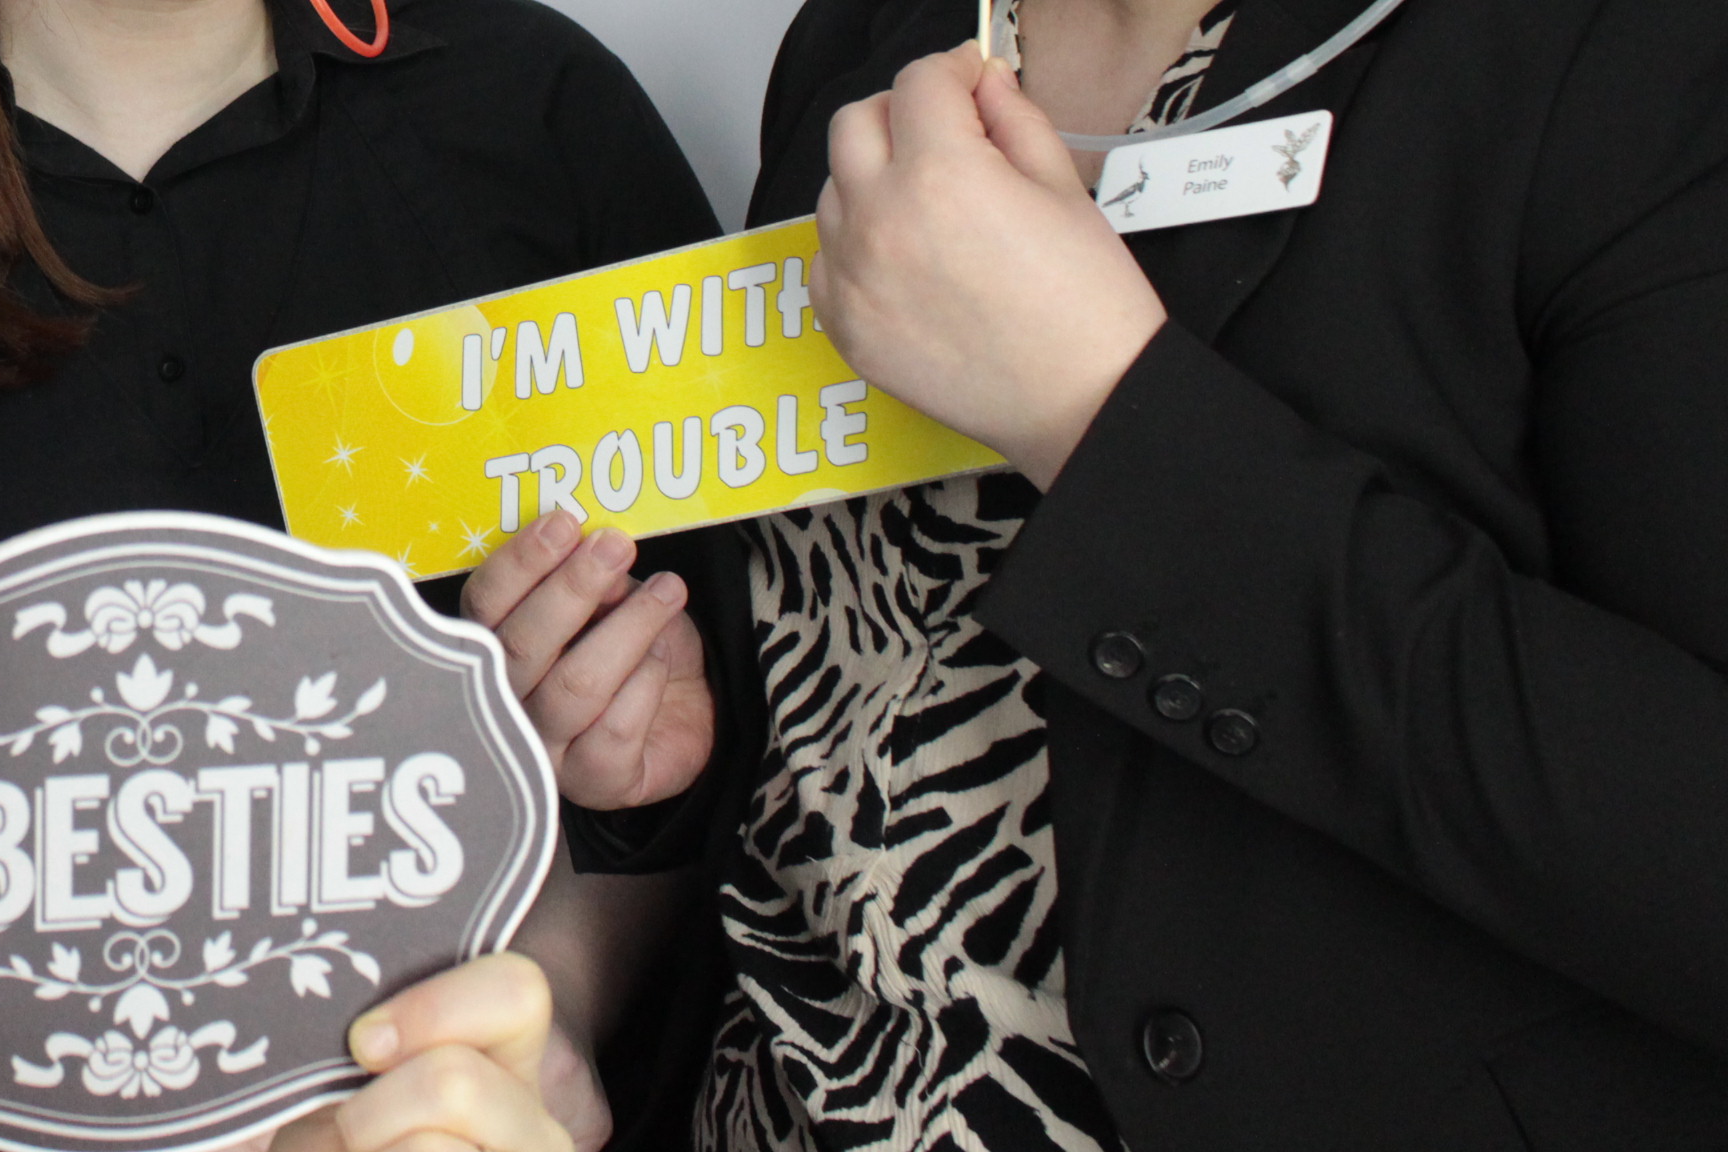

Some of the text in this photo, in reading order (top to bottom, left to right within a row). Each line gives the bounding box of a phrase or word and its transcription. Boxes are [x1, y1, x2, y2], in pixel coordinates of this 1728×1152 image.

[1183, 179, 1228, 196] Paine
[1187, 154, 1232, 174] Emily
[461, 312, 584, 410] I'M
[484, 379, 868, 533] TROUBLE
